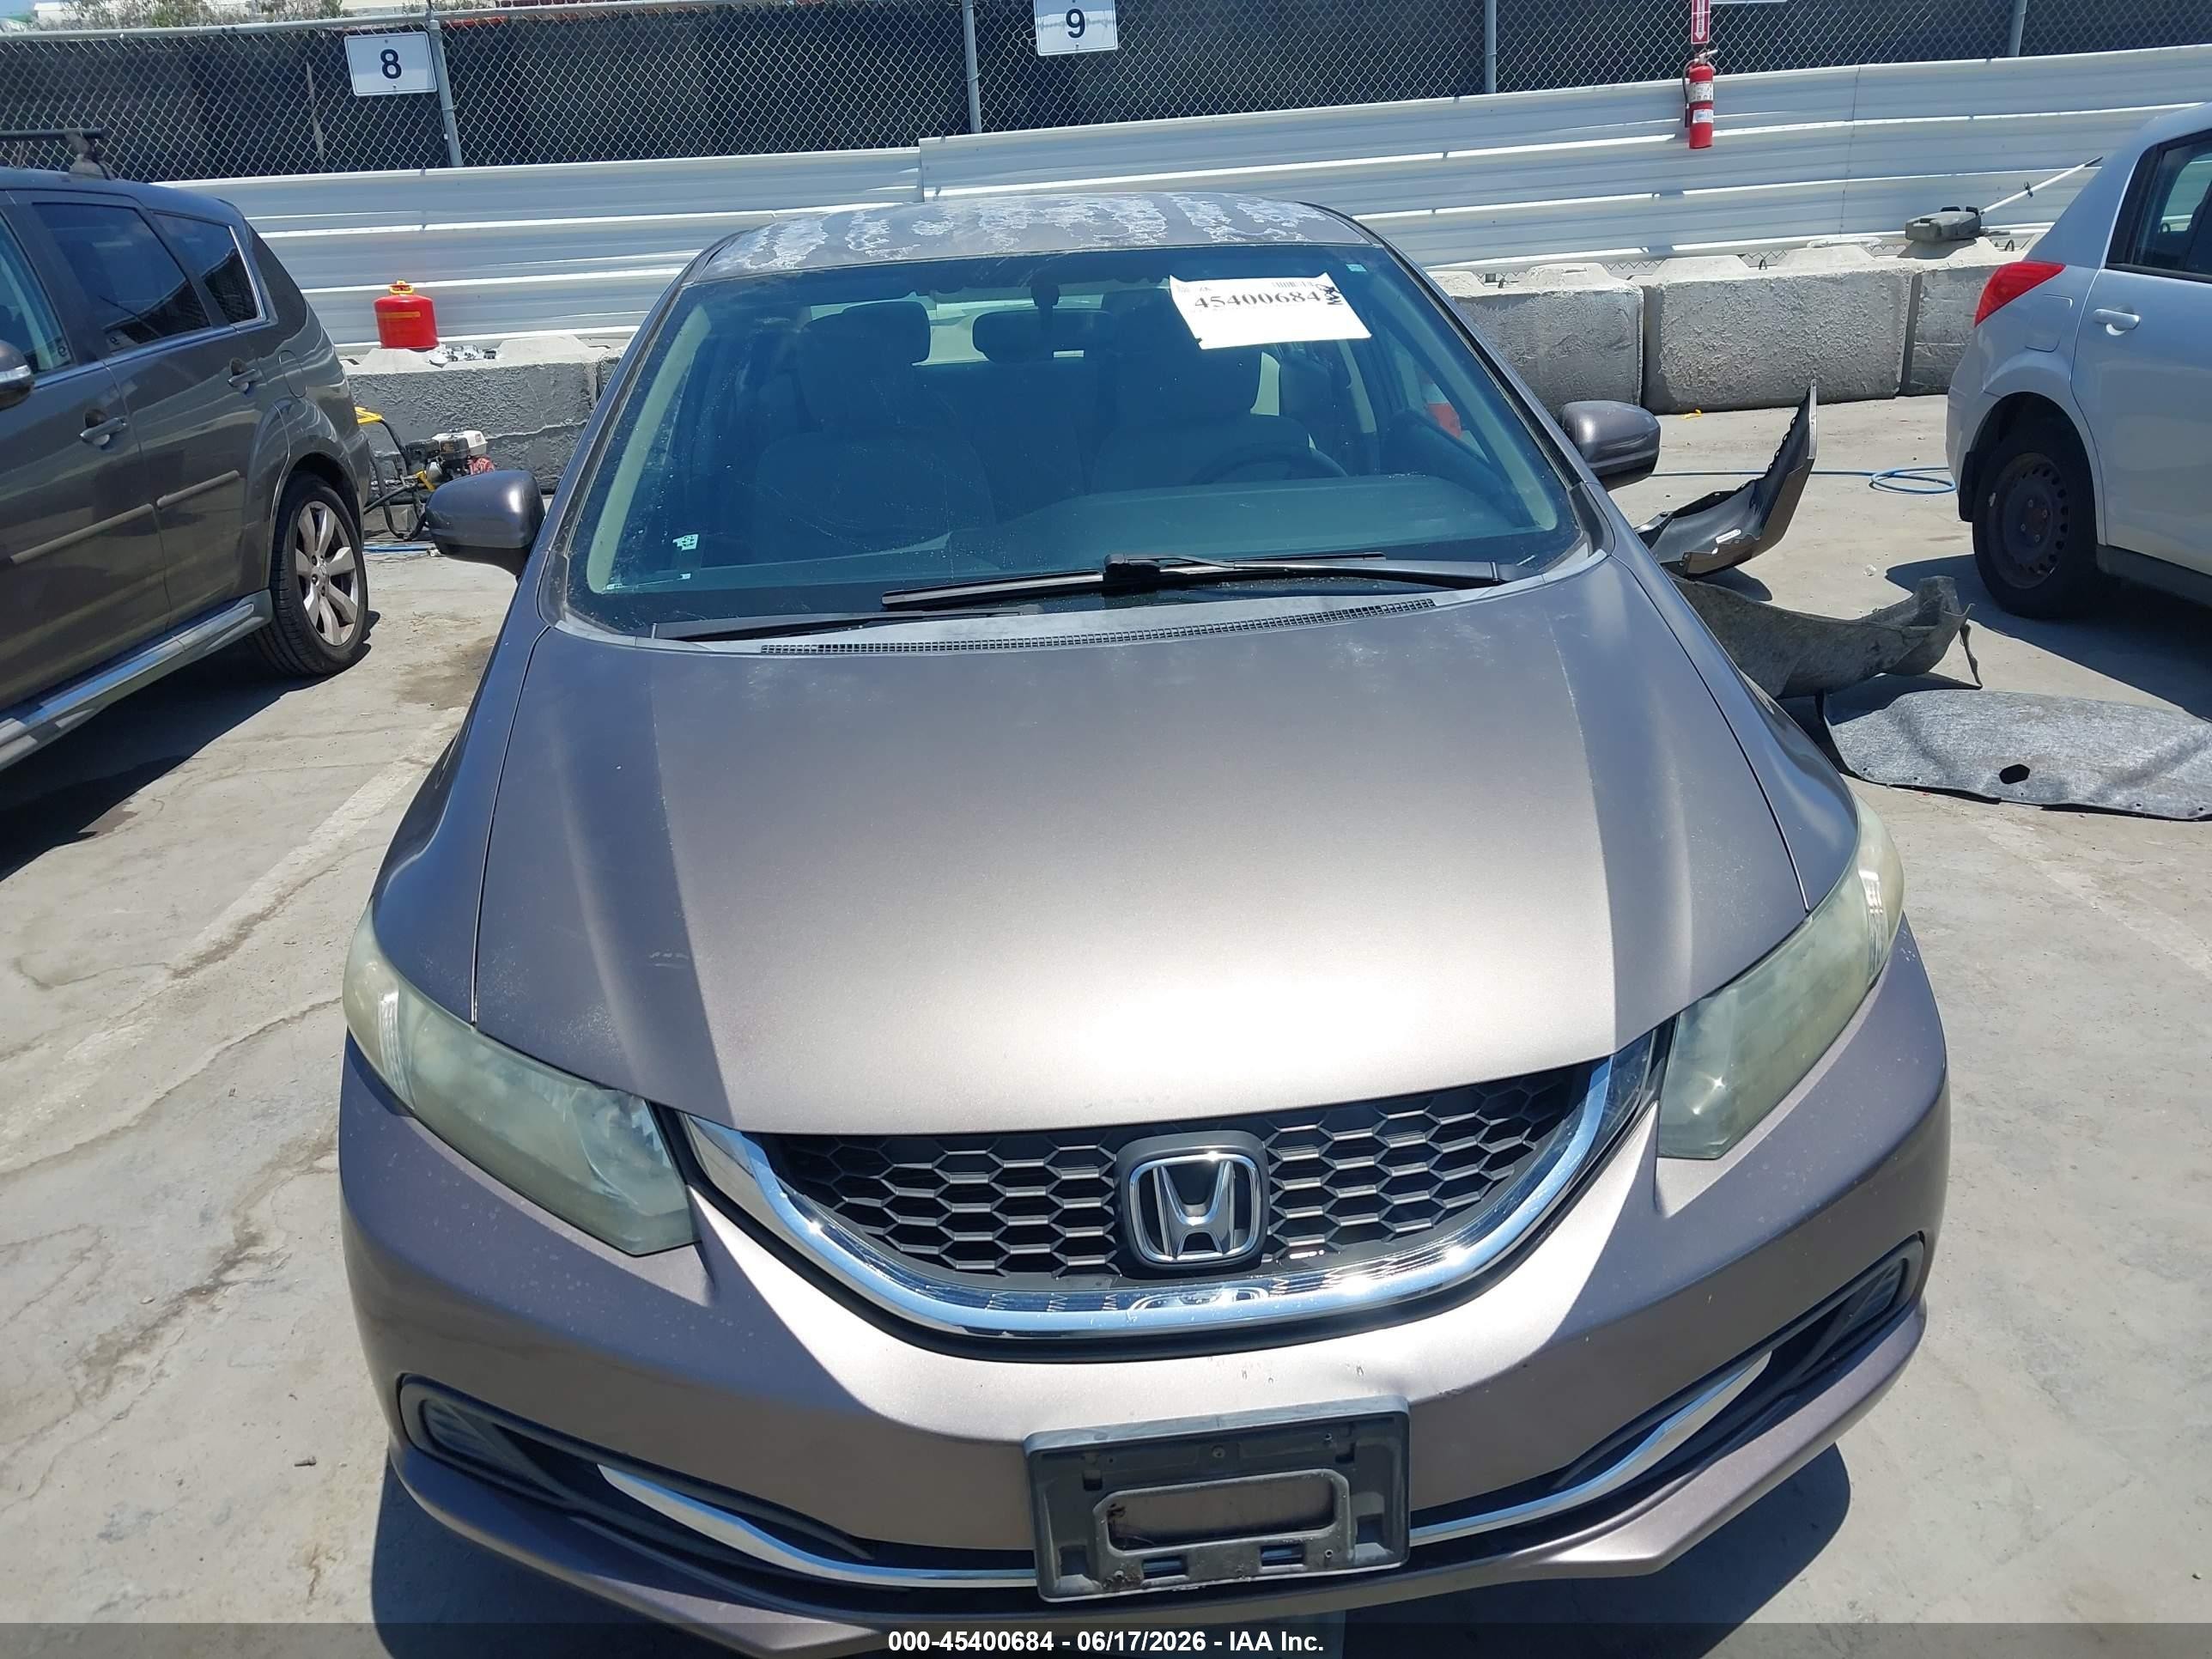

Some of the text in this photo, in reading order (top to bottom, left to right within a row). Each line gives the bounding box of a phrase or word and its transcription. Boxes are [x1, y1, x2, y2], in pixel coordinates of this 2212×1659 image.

[1066, 8, 1085, 39] 9
[380, 48, 402, 80] 8
[1194, 290, 1322, 308] 45400684
